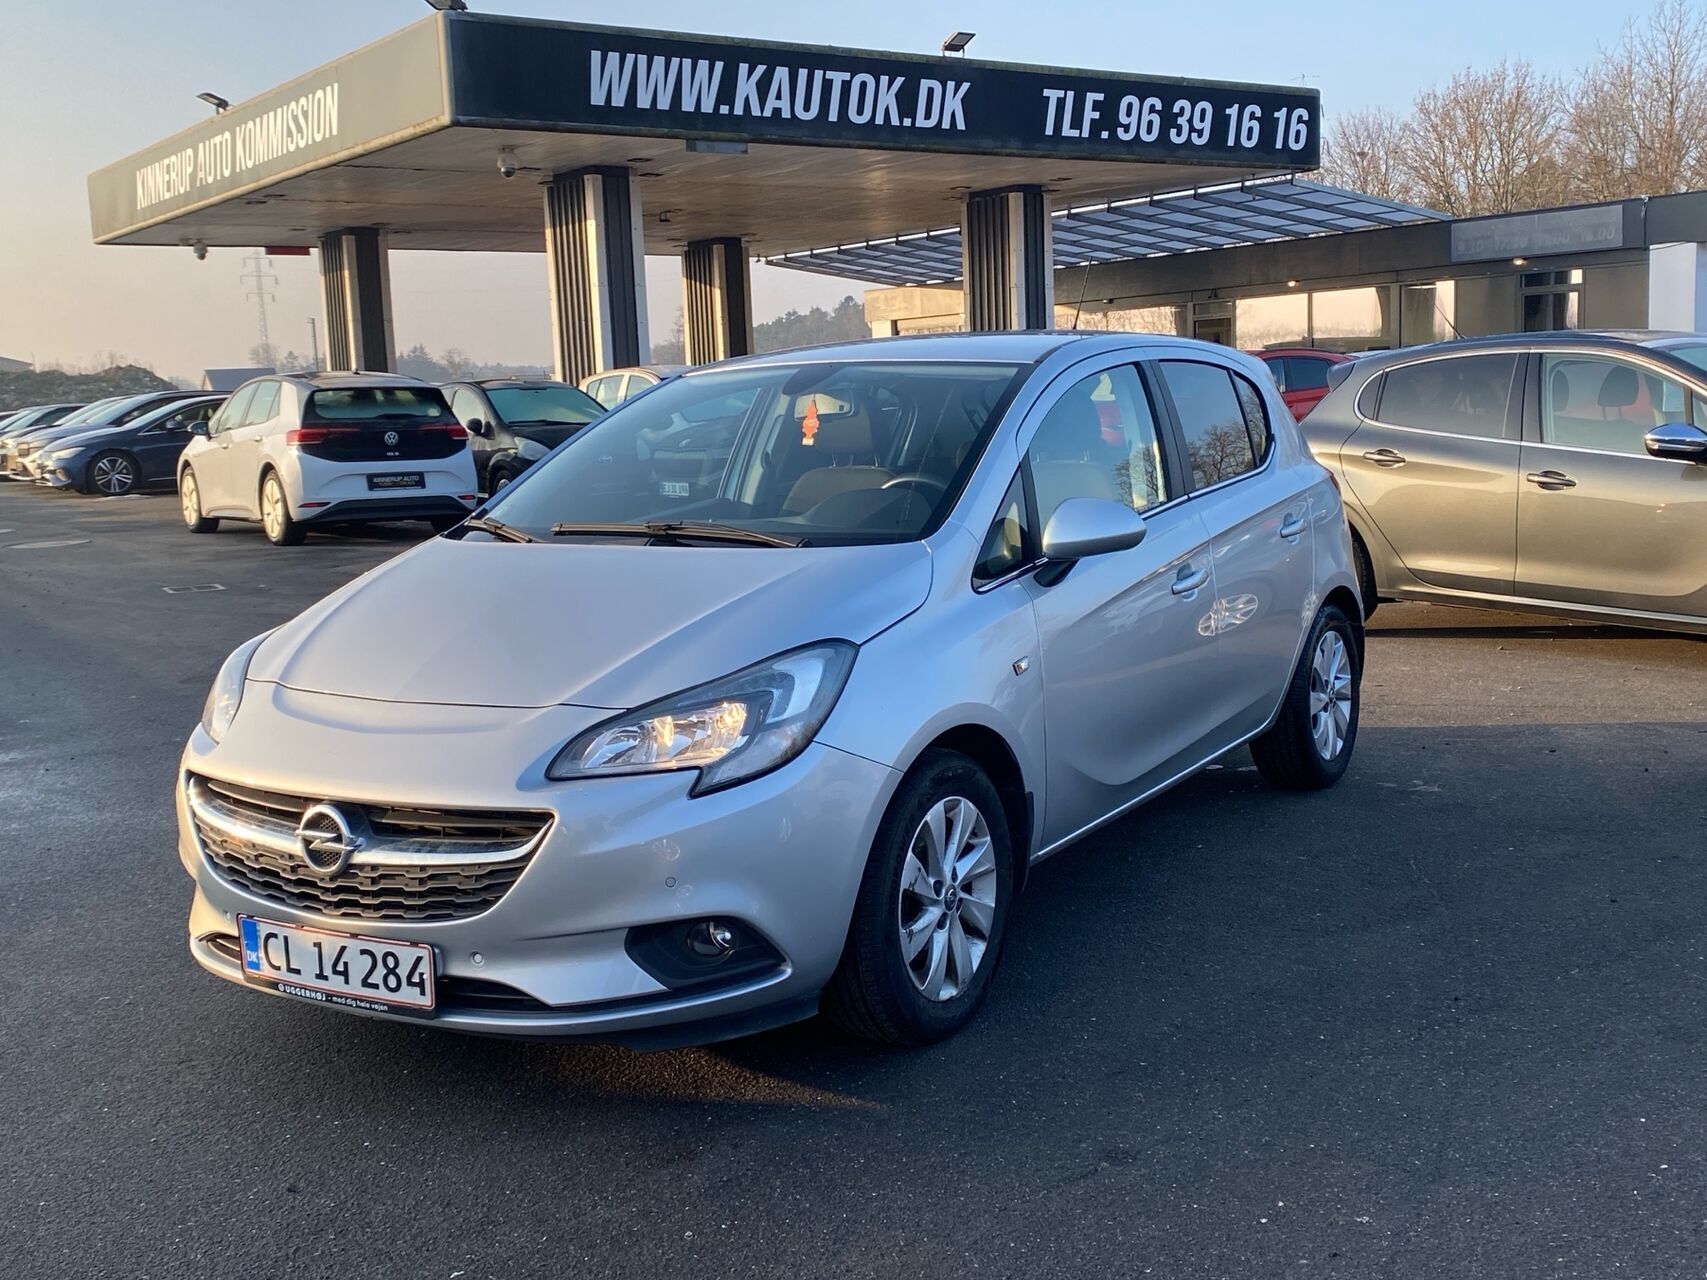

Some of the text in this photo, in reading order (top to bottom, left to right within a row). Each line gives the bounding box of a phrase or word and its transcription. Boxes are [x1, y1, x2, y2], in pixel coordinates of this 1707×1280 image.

[590, 50, 971, 130] WWW.KAUTOK.DK
[1043, 88, 1309, 151] TLF. 96 39 16 16
[136, 83, 339, 210] KINNERUP AUTO KOMMISSION
[247, 950, 259, 963] DK
[263, 932, 427, 996] CL 14 284
